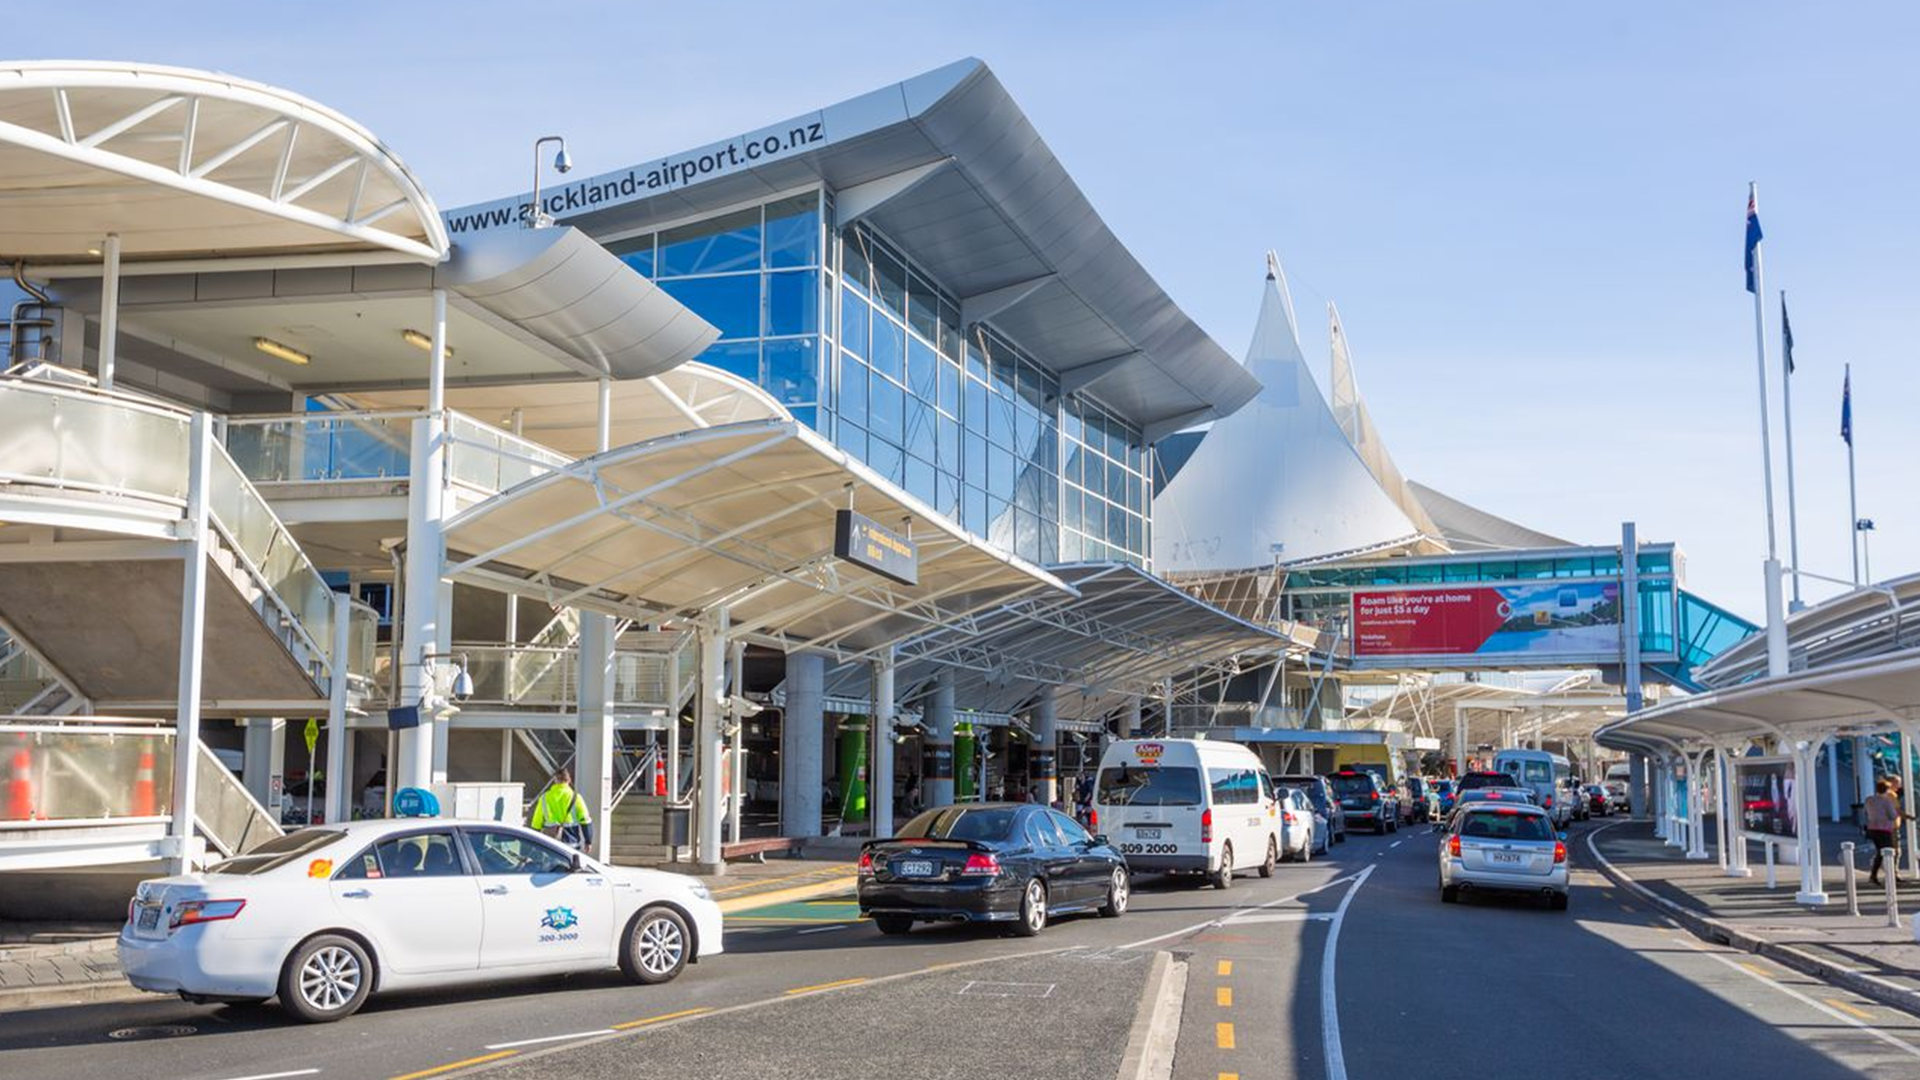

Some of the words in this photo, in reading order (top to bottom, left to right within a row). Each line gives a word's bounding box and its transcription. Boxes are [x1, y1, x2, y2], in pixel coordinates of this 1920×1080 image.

[1361, 597, 1386, 605] Roam
[1387, 596, 1403, 604] like
[1405, 595, 1433, 605] you're
[1435, 595, 1445, 603] at
[1445, 594, 1471, 602] home
[1361, 607, 1374, 615] for
[1374, 606, 1392, 617] just
[1394, 605, 1404, 615] $5
[1413, 605, 1430, 615] day
[1120, 843, 1143, 854] 309
[1145, 843, 1178, 854] 2000
[538, 932, 579, 942] 300-3000
